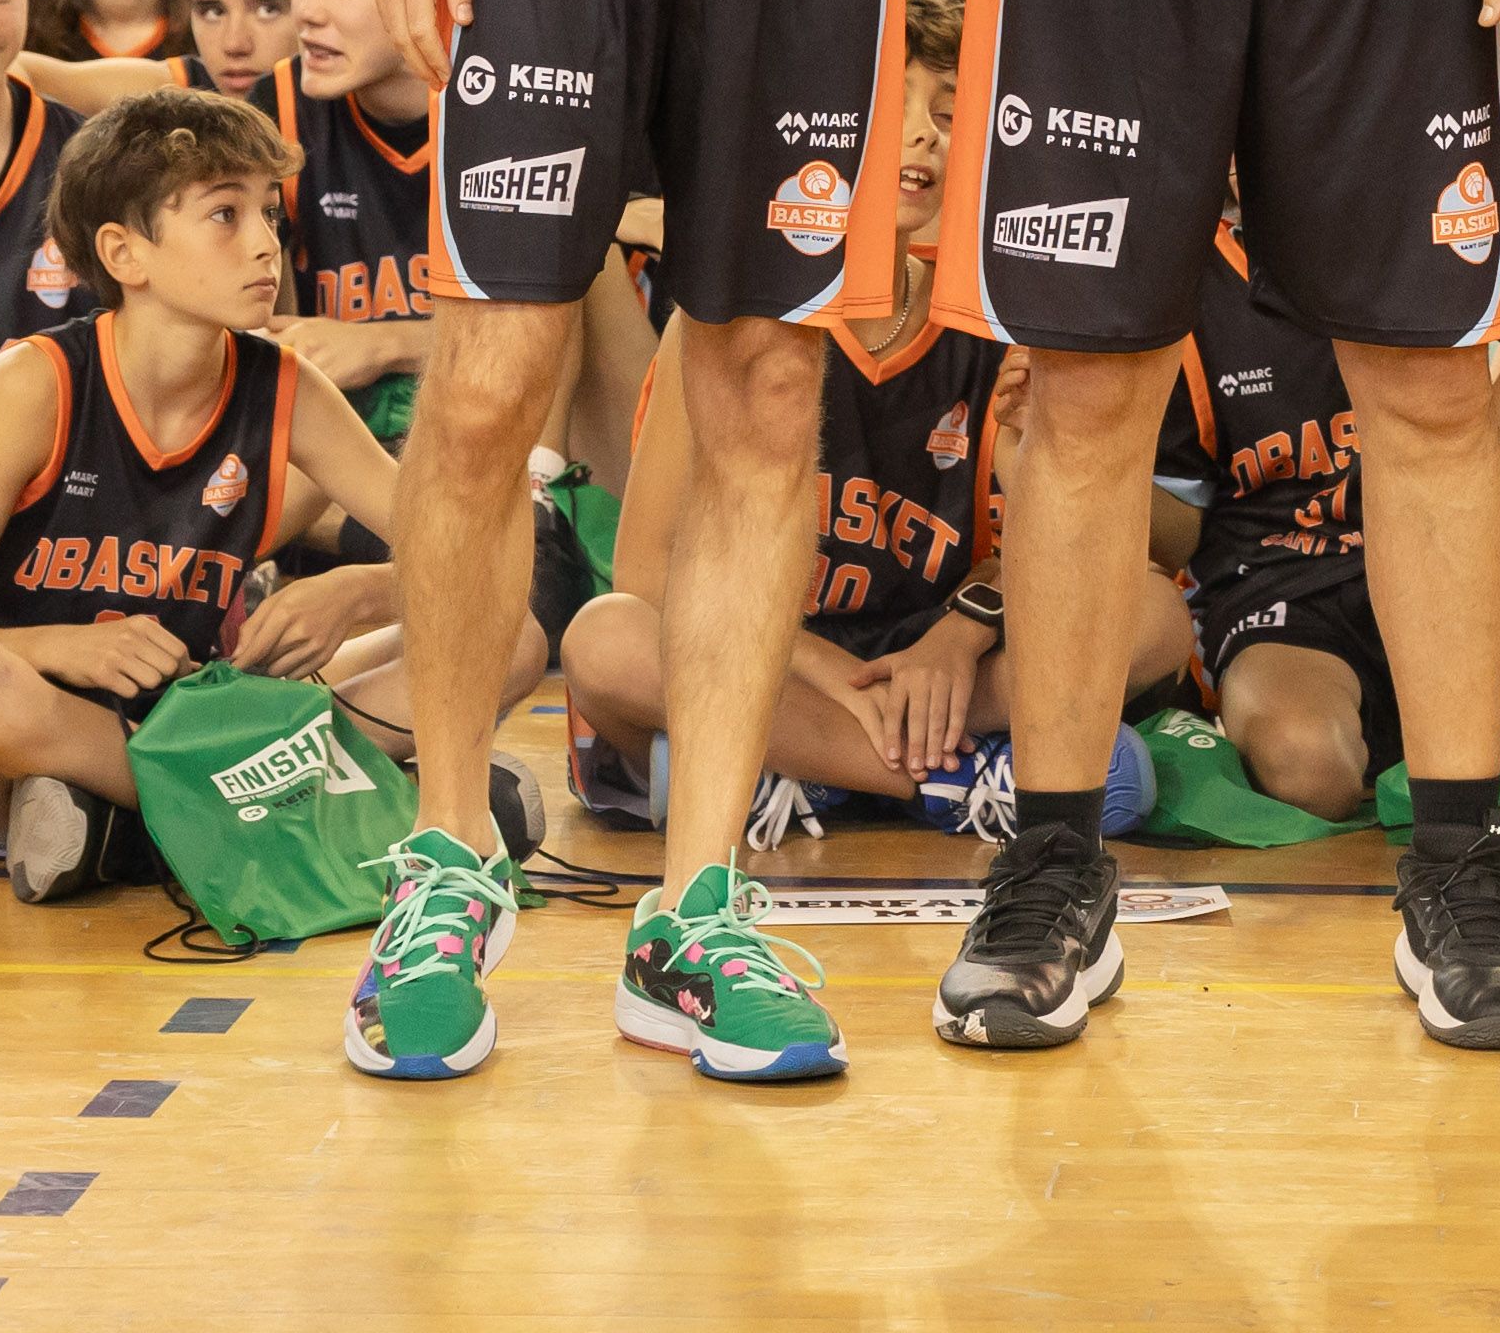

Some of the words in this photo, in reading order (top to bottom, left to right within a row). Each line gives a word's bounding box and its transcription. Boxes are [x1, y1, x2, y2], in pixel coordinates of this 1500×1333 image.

[509, 64, 594, 95] KERN
[508, 91, 591, 109] PHARMA
[811, 112, 859, 128] MARC
[1462, 104, 1491, 127] MARC
[1047, 107, 1141, 144] KERN
[809, 132, 857, 148] MART
[1046, 135, 1137, 157] PHARMA
[1463, 126, 1491, 149] MART
[1438, 209, 1496, 236] BASKET
[1237, 367, 1273, 381] MARC
[1240, 382, 1274, 395] MART
[70, 470, 98, 485] MARC
[66, 484, 95, 498] MART
[14, 536, 243, 610] QBASKET
[752, 897, 986, 910] REINFAN
[874, 909, 917, 918] M
[938, 909, 958, 918] 1
